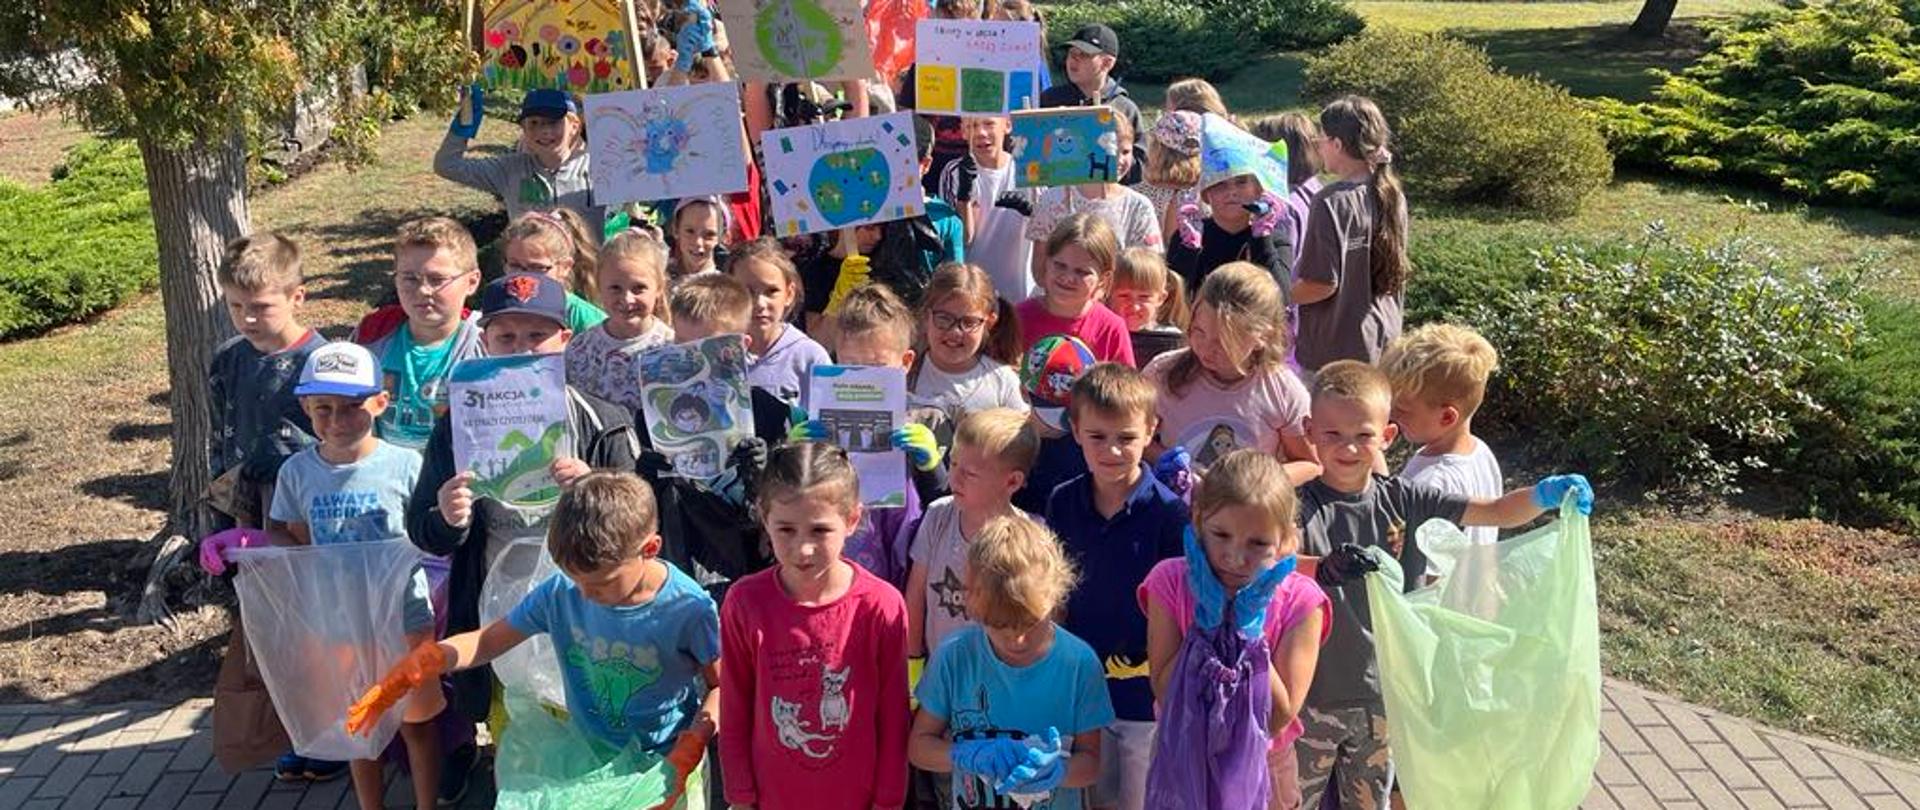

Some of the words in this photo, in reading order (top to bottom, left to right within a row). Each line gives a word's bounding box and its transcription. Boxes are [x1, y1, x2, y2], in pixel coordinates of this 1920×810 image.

[463, 389, 485, 410] 31
[487, 389, 526, 401] AKCJA
[312, 490, 378, 507] ALWAYS
